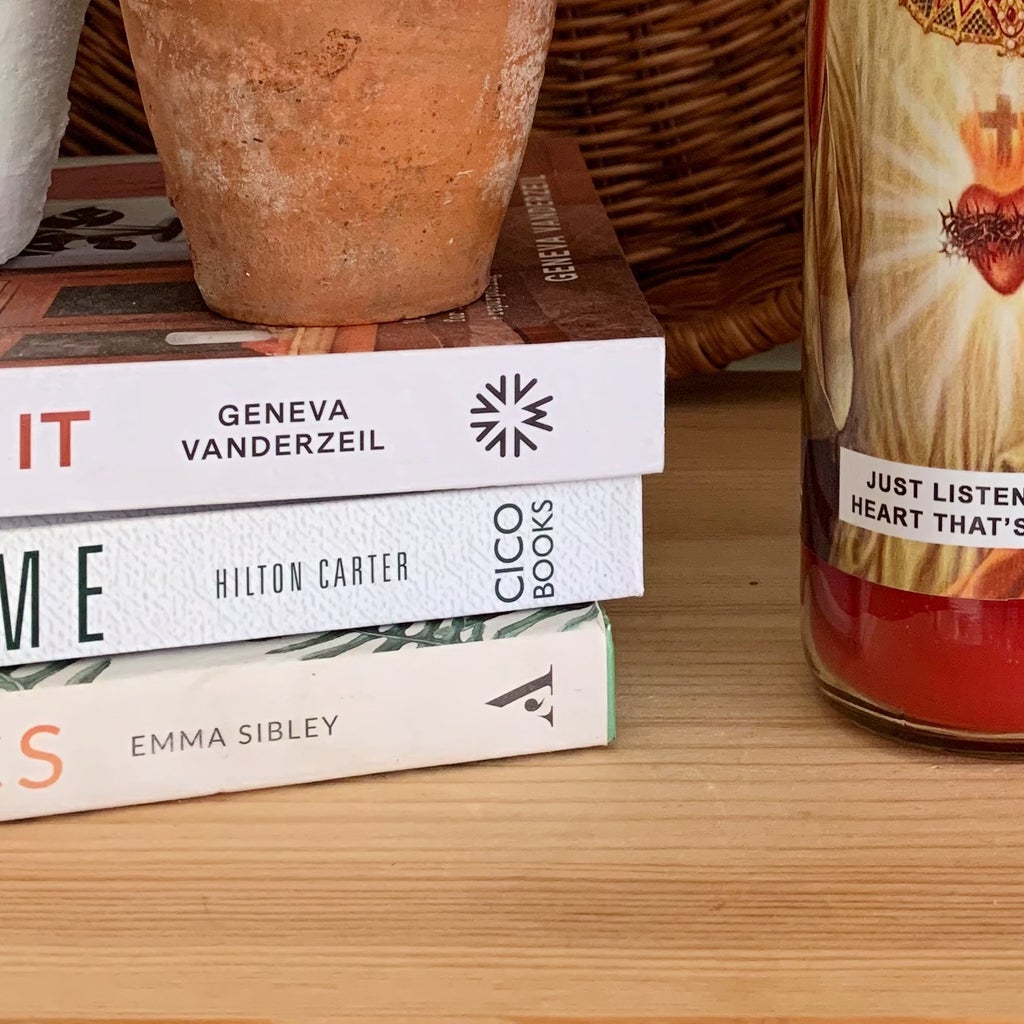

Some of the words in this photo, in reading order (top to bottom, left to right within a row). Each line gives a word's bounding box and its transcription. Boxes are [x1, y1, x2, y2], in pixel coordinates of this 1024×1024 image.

[535, 235, 579, 282] GENEVA
[218, 399, 349, 427] GENEVA
[19, 410, 91, 470] IT
[181, 429, 385, 461] VANDERZEIL
[866, 471, 923, 499] JUST
[851, 494, 923, 530] HEART
[493, 502, 525, 604] CICO
[532, 499, 555, 599] BOOKS
[216, 561, 302, 599] HILTON
[319, 551, 409, 589] CARTER
[0, 724, 63, 789] S
[131, 727, 227, 757] EMMA
[239, 714, 340, 745] SIBLEY
